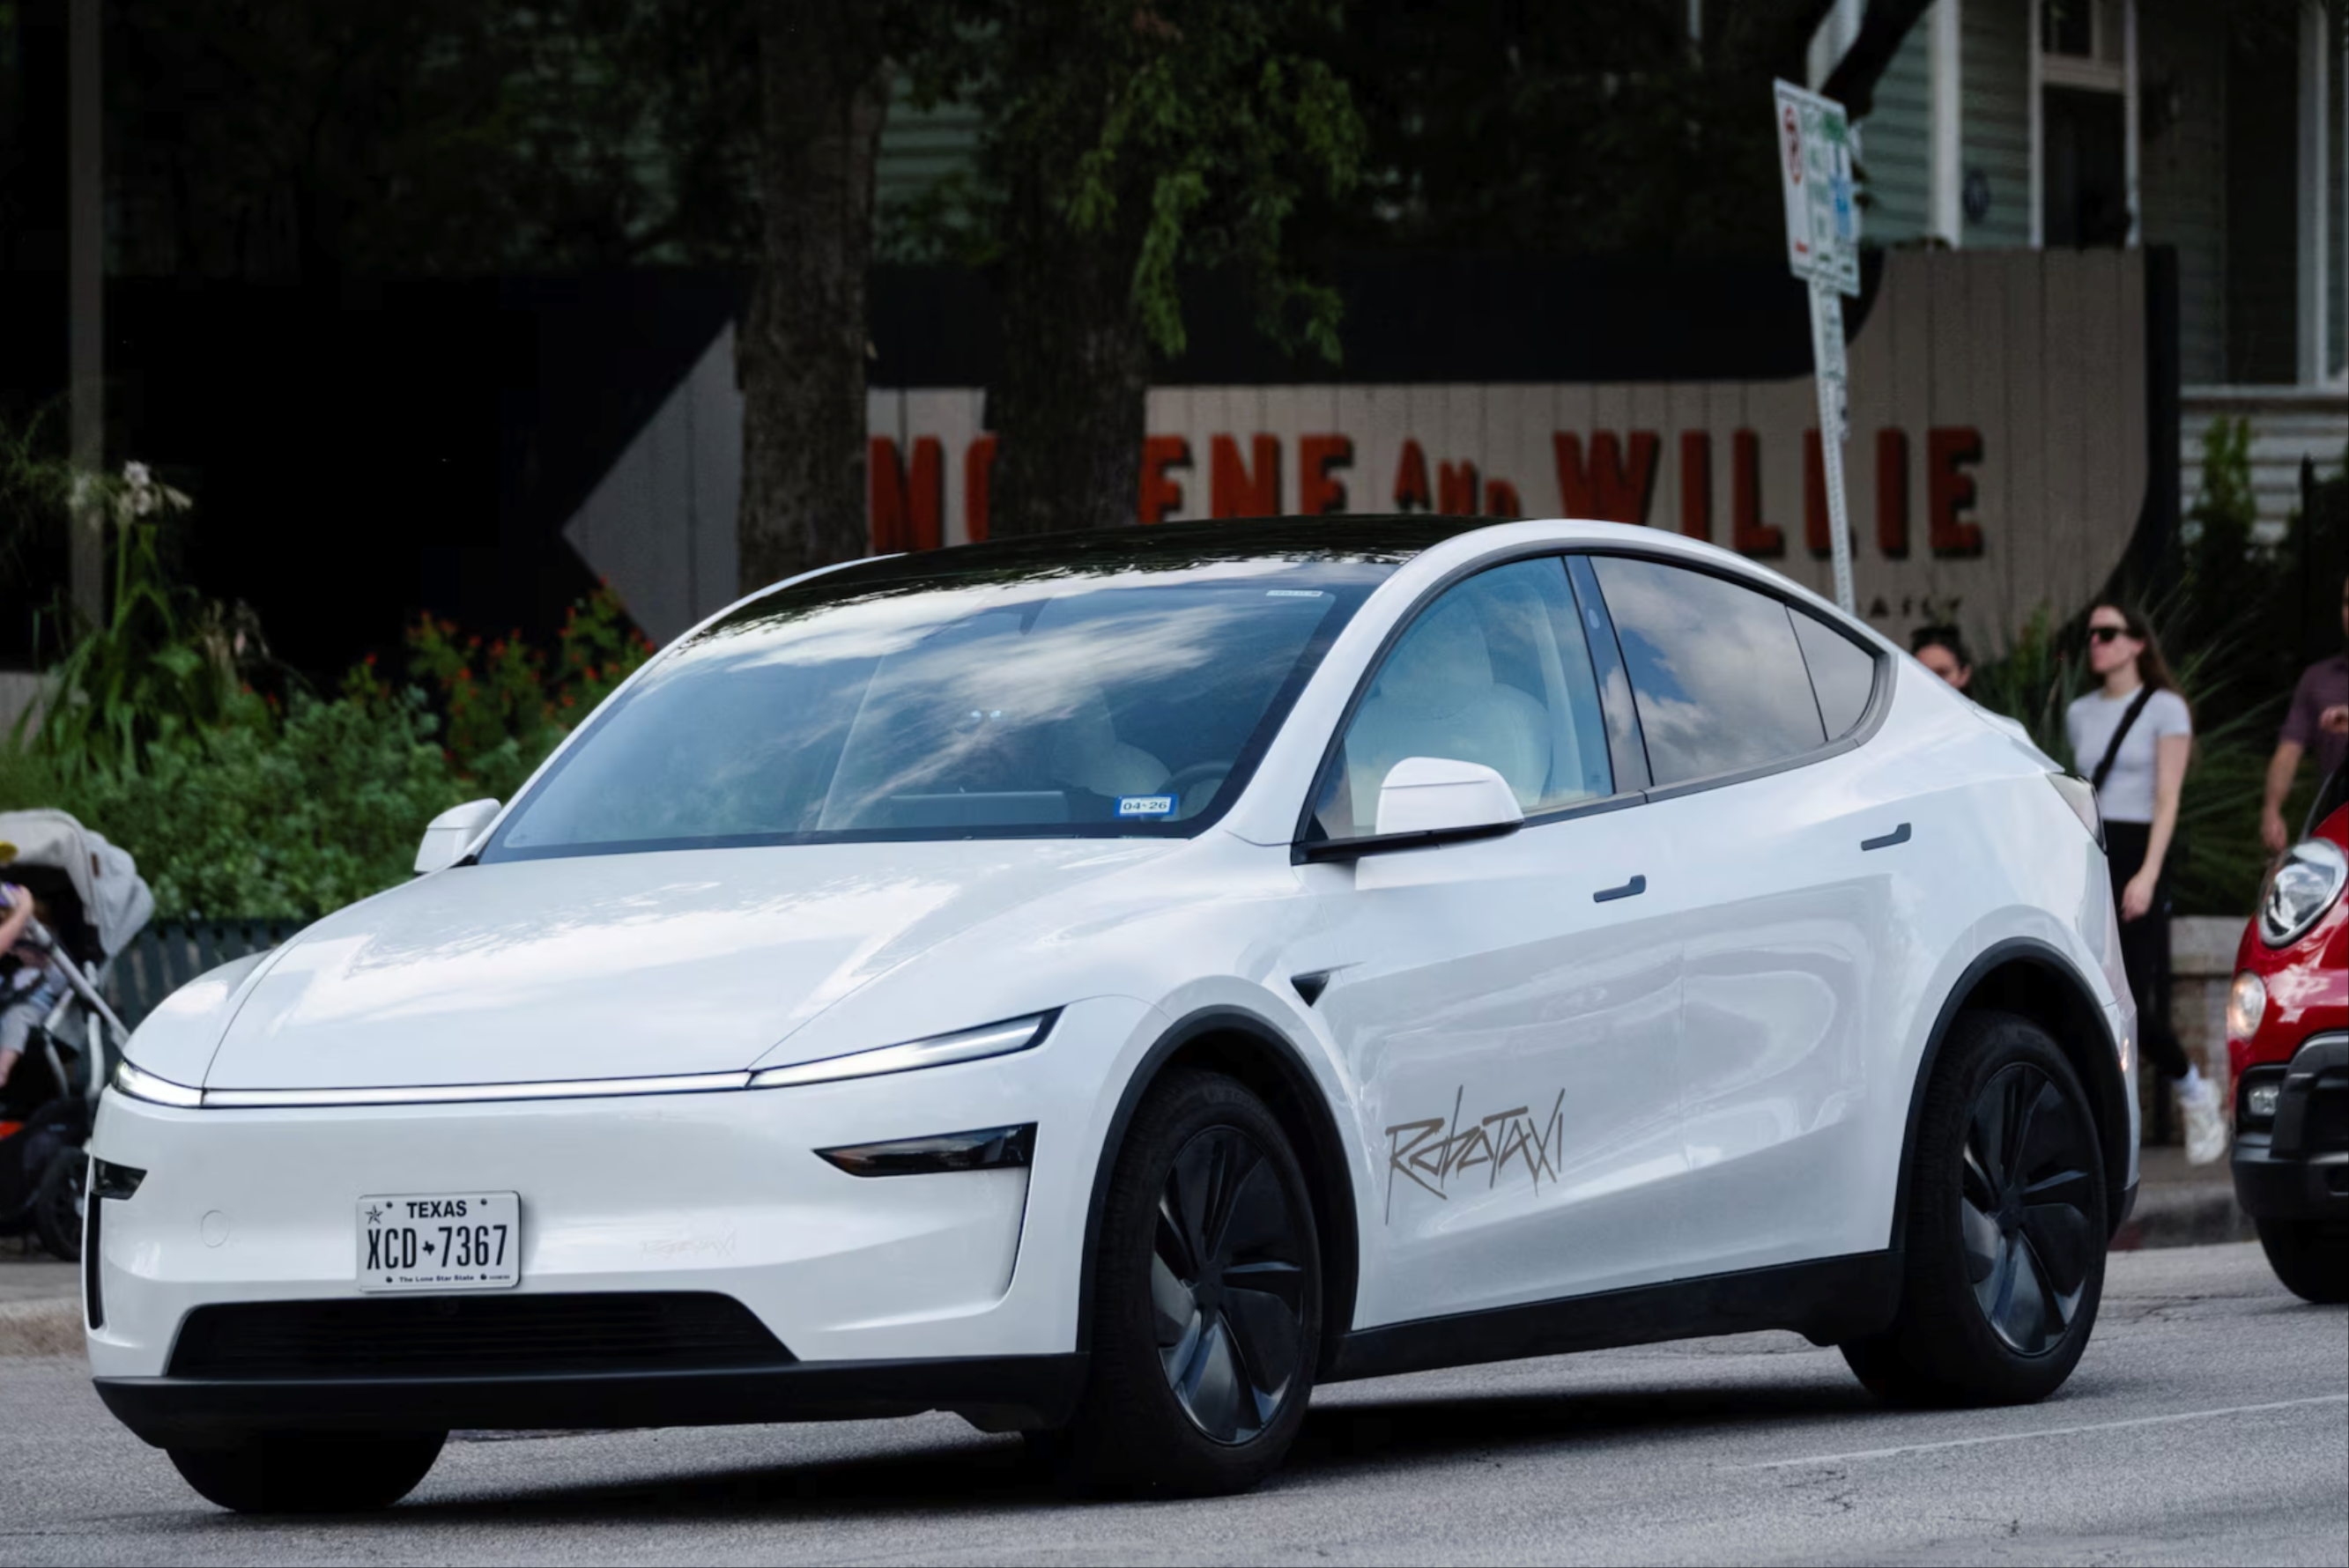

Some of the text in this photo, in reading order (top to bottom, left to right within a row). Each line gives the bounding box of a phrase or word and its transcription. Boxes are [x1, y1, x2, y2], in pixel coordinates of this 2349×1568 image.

[1552, 427, 1982, 558] WILLIE
[406, 1200, 468, 1219] TEXAS
[367, 1224, 508, 1270] XCD 7367
